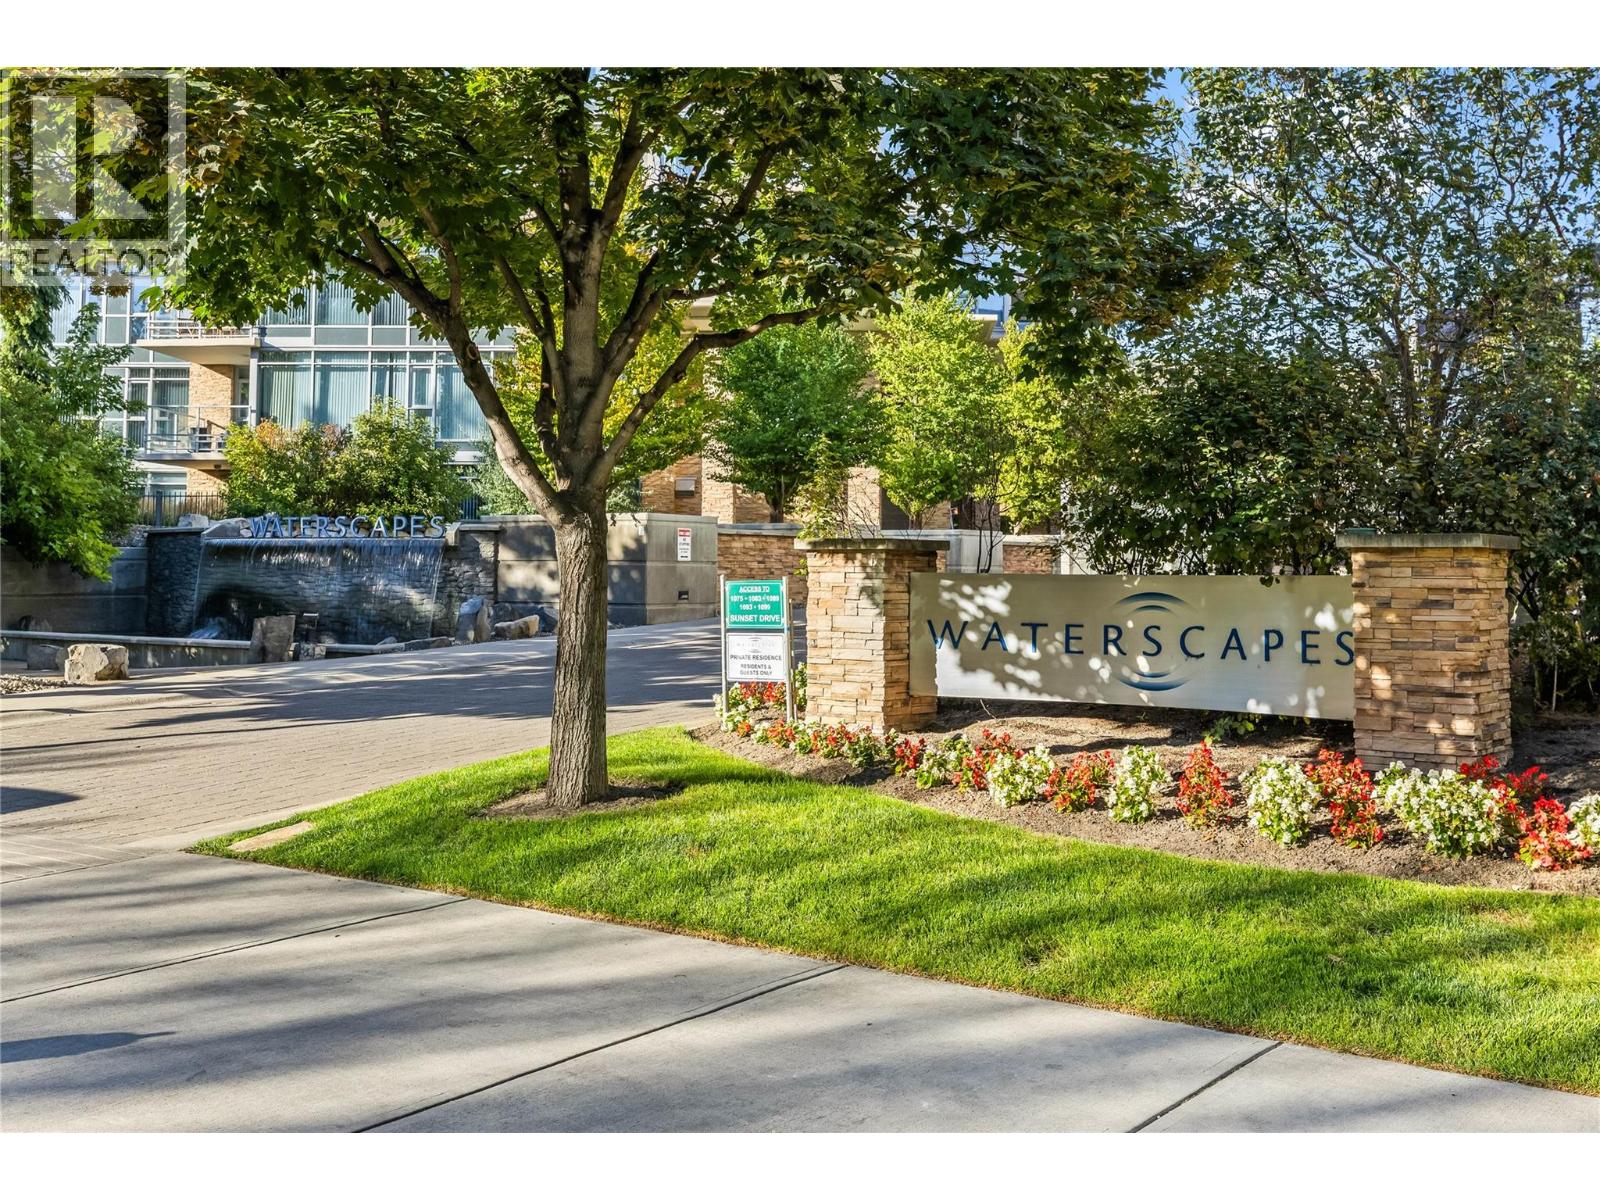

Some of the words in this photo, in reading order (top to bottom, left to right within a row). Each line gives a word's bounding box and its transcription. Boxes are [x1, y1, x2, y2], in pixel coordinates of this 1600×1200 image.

[249, 514, 445, 538] WATERSCAPES
[739, 585, 761, 593] ACCESS
[761, 585, 770, 593] TO
[730, 614, 758, 622] SUNSET
[759, 614, 780, 622] DRIVE
[927, 618, 1355, 667] WATERSCAPES
